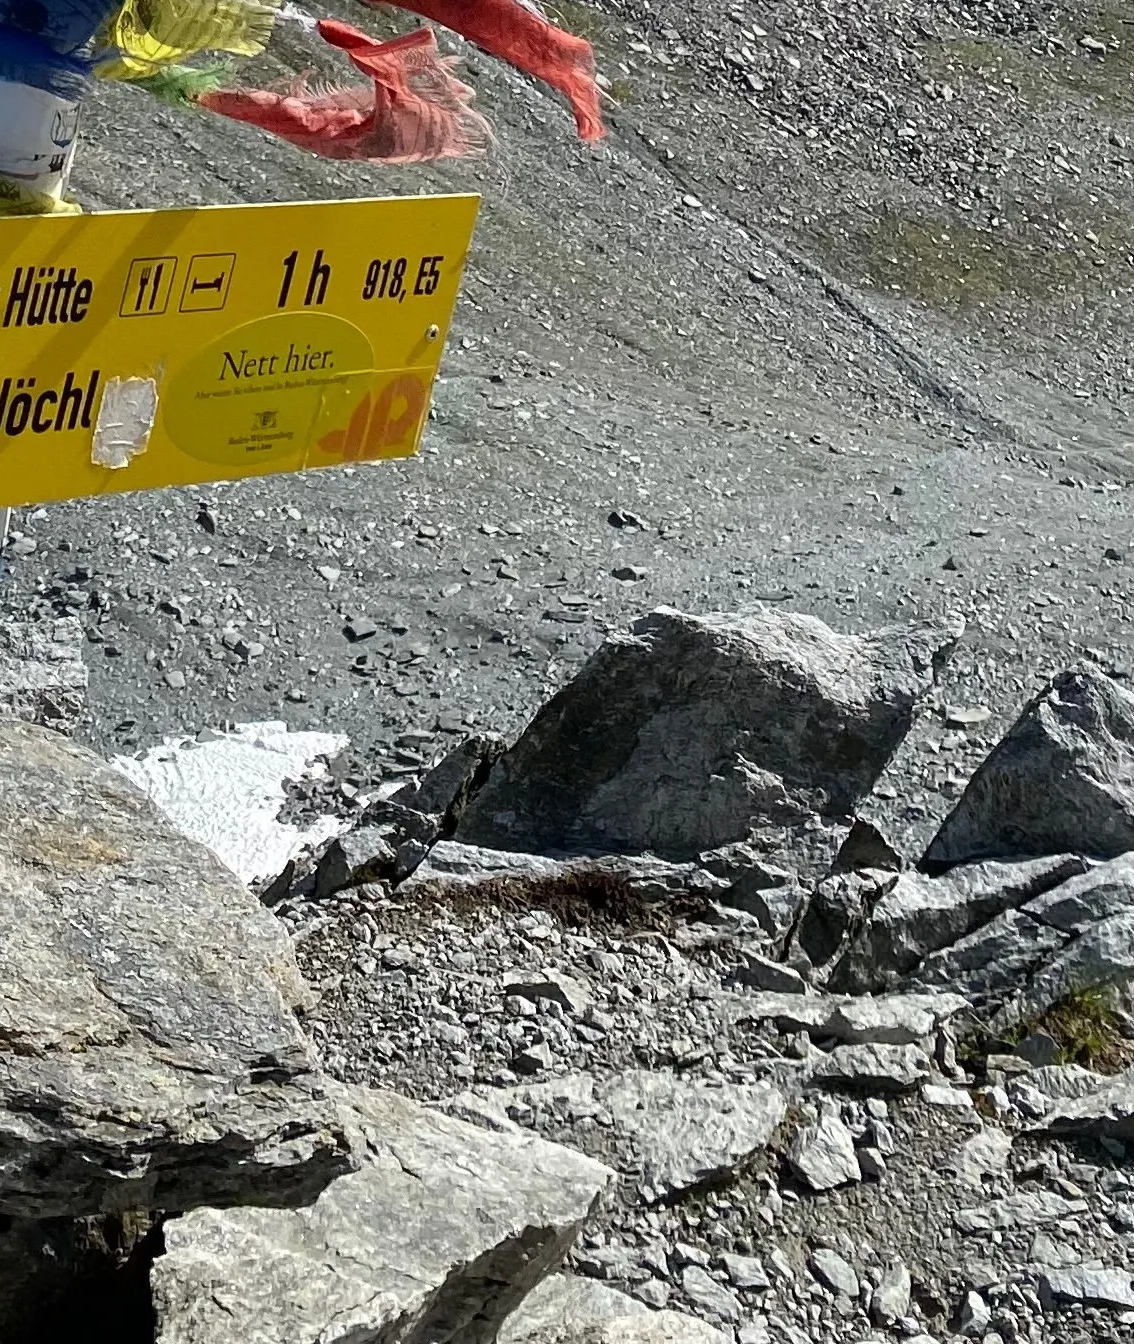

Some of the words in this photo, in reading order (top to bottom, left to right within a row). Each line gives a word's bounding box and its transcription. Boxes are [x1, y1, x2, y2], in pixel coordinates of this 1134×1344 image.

[3, 266, 93, 328] Hütte
[362, 257, 408, 304] 918,
[413, 255, 444, 296] E5
[218, 349, 280, 381] Nett
[283, 343, 334, 374] hier.
